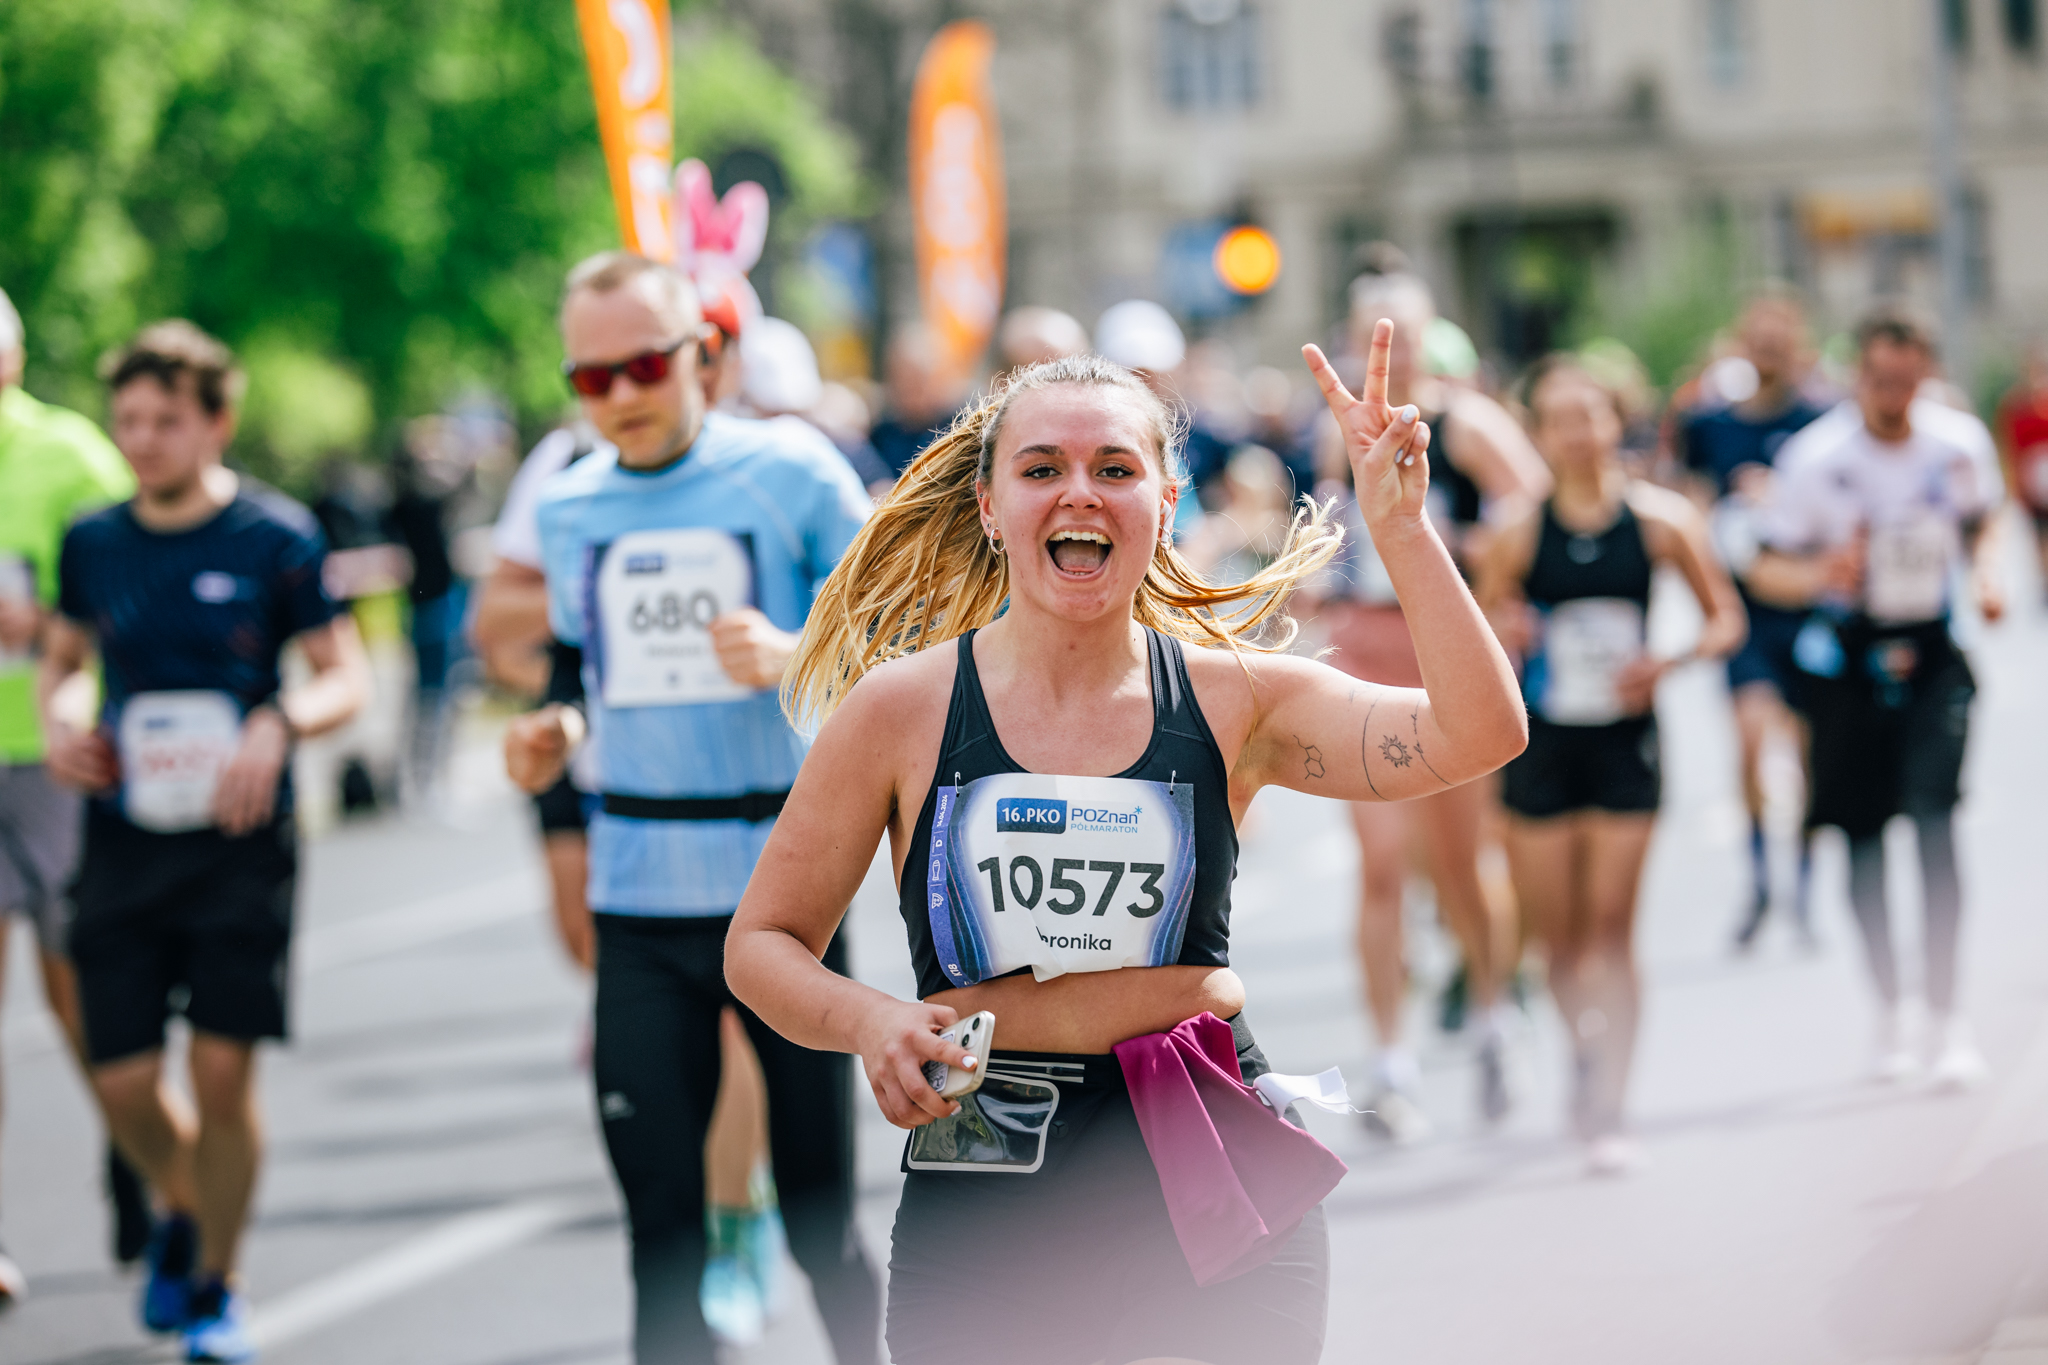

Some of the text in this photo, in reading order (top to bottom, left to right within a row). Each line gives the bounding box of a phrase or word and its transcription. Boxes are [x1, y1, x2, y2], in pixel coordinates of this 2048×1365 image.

[628, 588, 720, 635] 680
[1002, 807, 1061, 824] 16.PKO
[1070, 823, 1138, 833] PÓŁMARATON
[977, 855, 1165, 918] 10573
